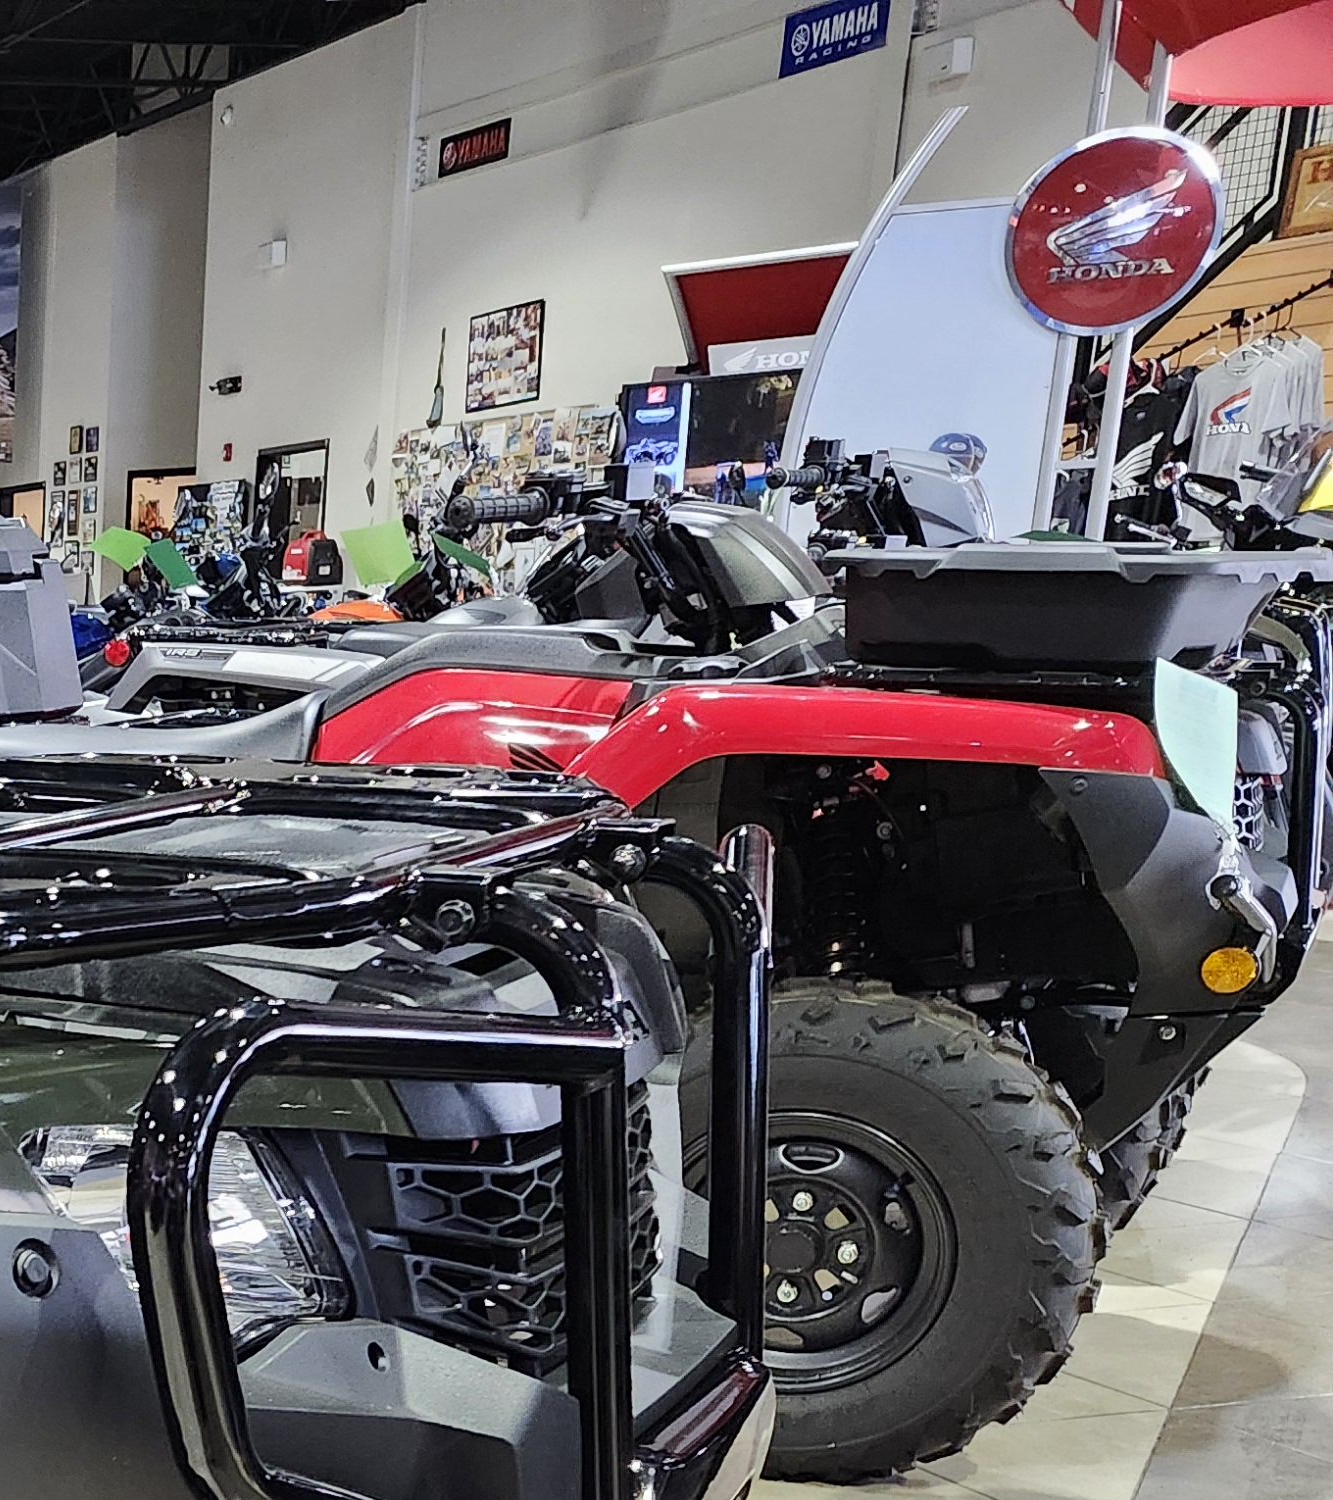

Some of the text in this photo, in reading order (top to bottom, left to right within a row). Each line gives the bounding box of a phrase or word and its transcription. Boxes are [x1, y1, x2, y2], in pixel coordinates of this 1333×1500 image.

[812, 2, 879, 50] YAMAHA
[795, 35, 872, 66] RACING
[457, 126, 506, 166] YAMAHA
[1047, 258, 1174, 285] HONDA
